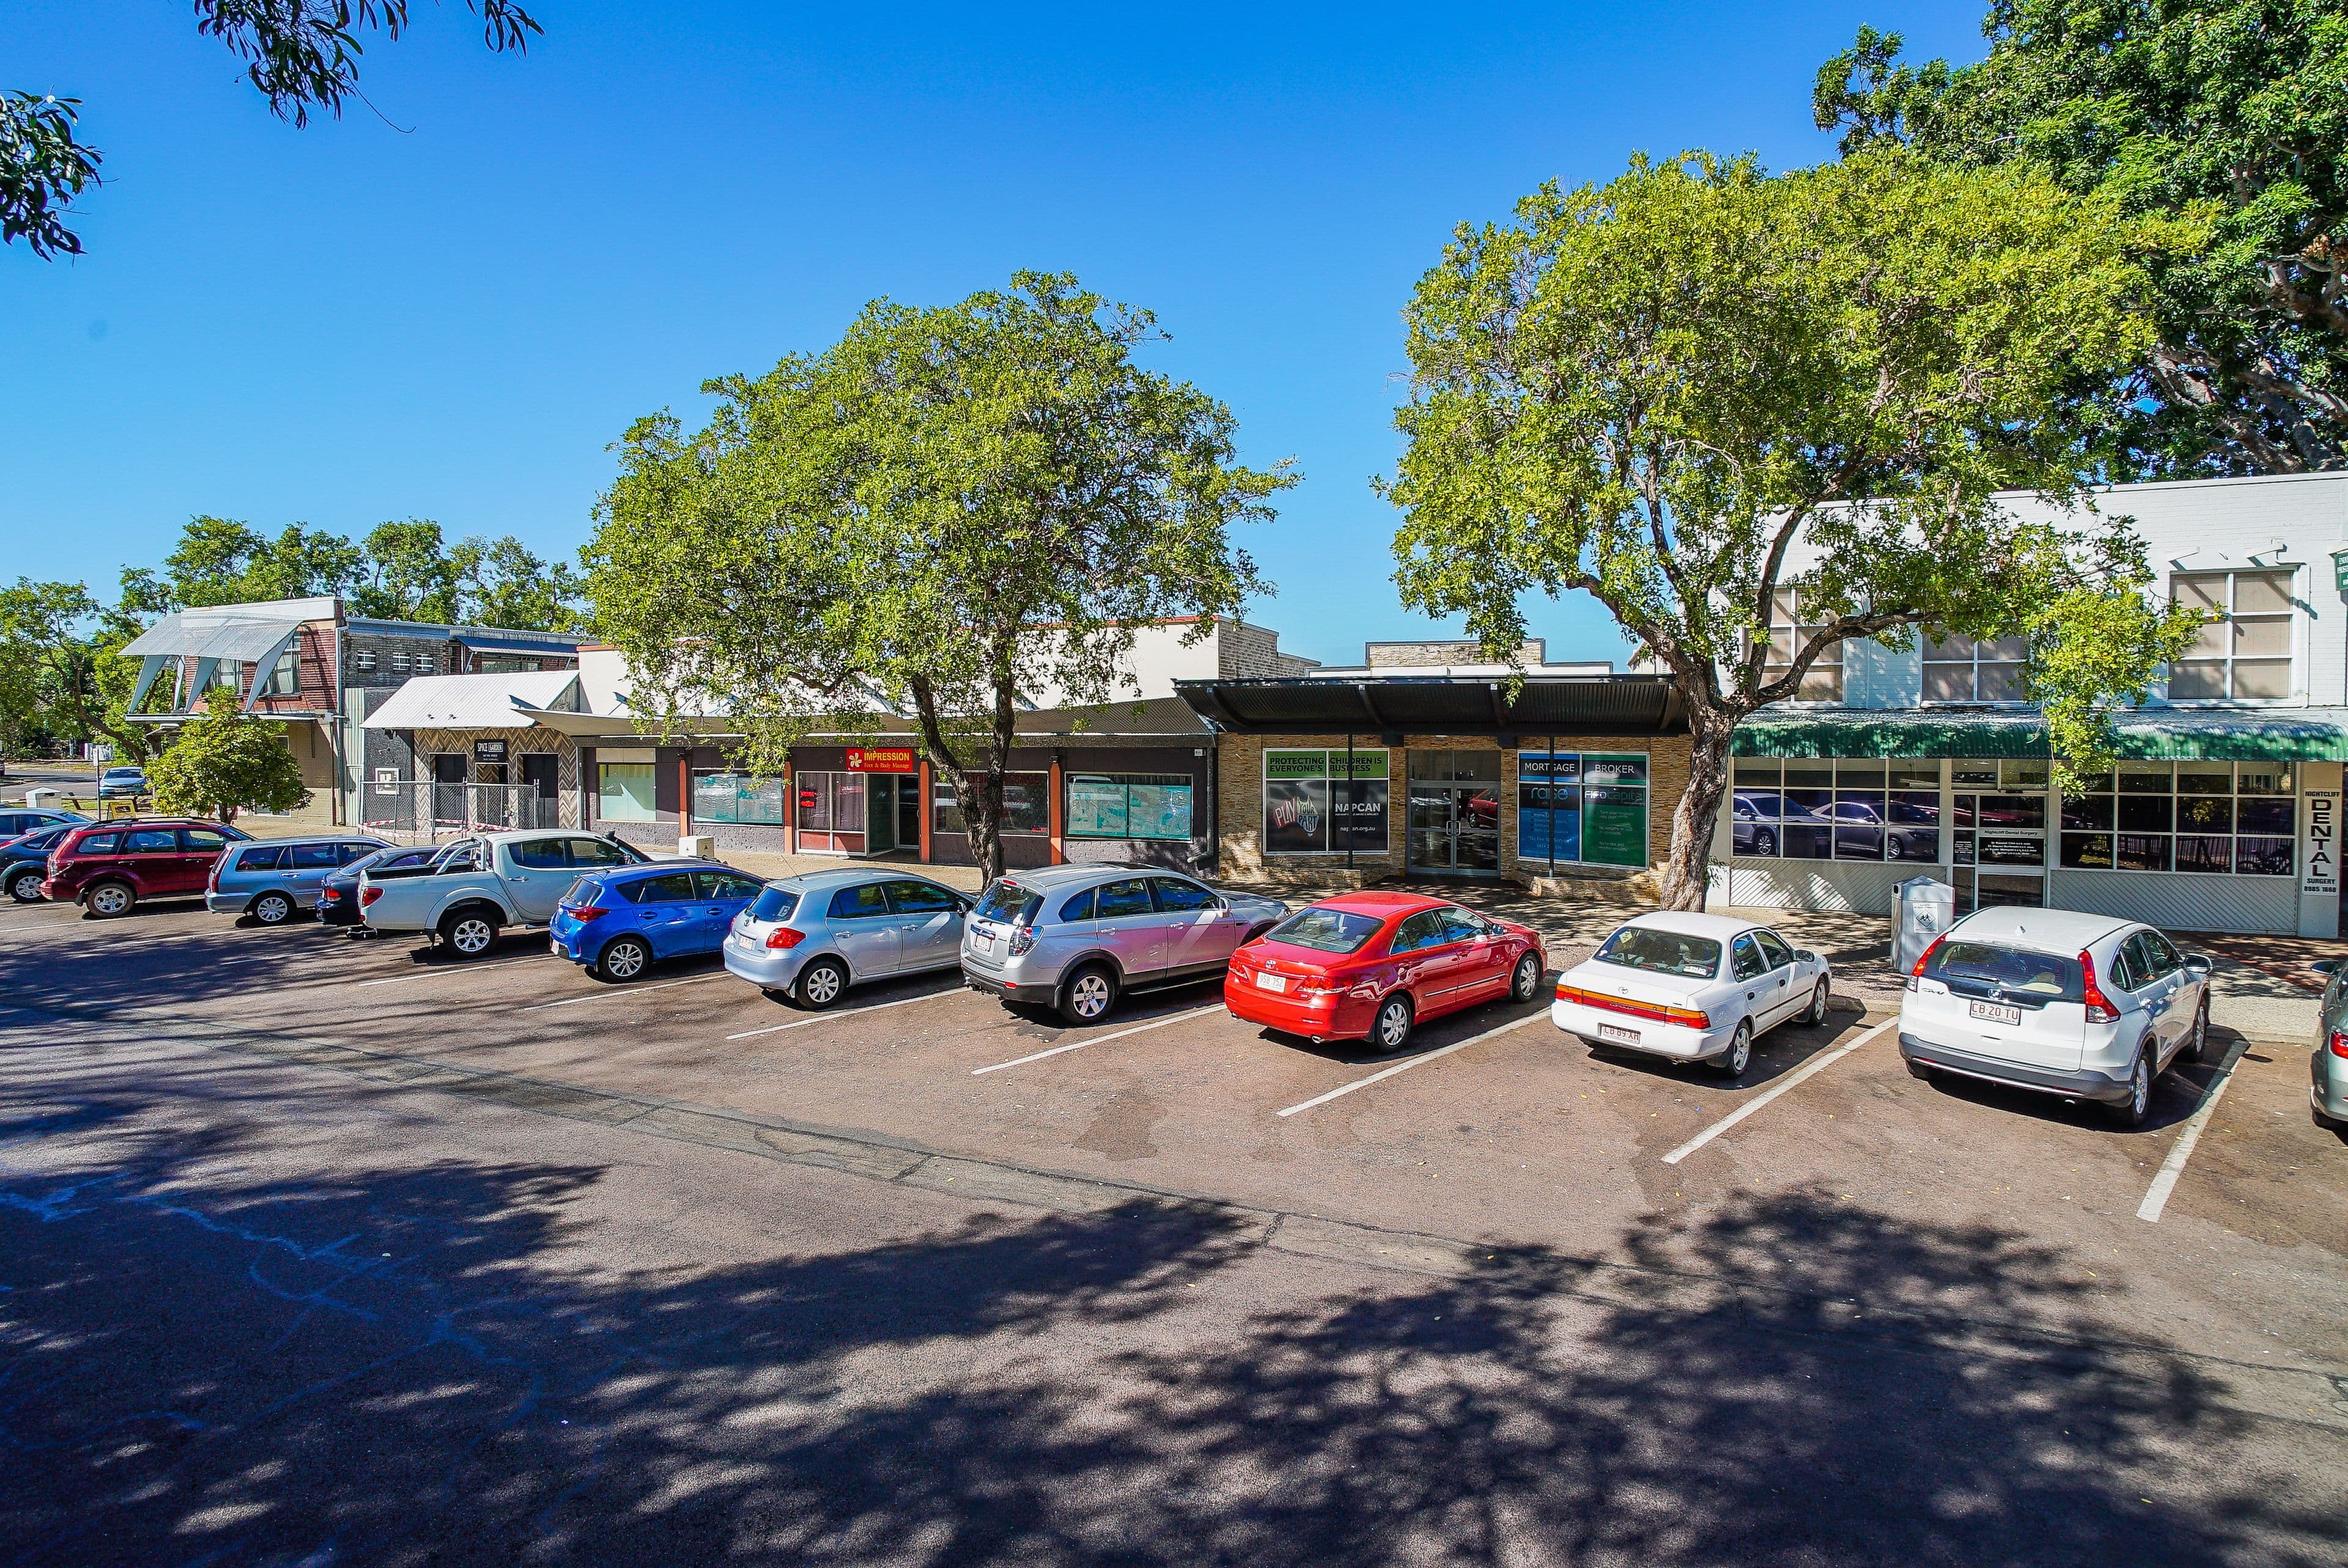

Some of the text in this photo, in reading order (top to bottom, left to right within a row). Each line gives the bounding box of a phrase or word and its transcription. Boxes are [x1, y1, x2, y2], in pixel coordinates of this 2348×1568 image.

[864, 752, 910, 761] IMPRESSION
[1595, 765, 1634, 774] BROKER
[1275, 798, 1296, 827] PLAY
[1297, 800, 1315, 814] YOUR
[1335, 803, 1381, 812] NAPCAN
[1298, 815, 1318, 831] PART
[2309, 799, 2331, 877] DENTAL
[1273, 977, 1283, 988] 752
[1972, 1003, 1985, 1014] CB
[1988, 1006, 2001, 1017] 20
[2005, 1009, 2018, 1020] TU
